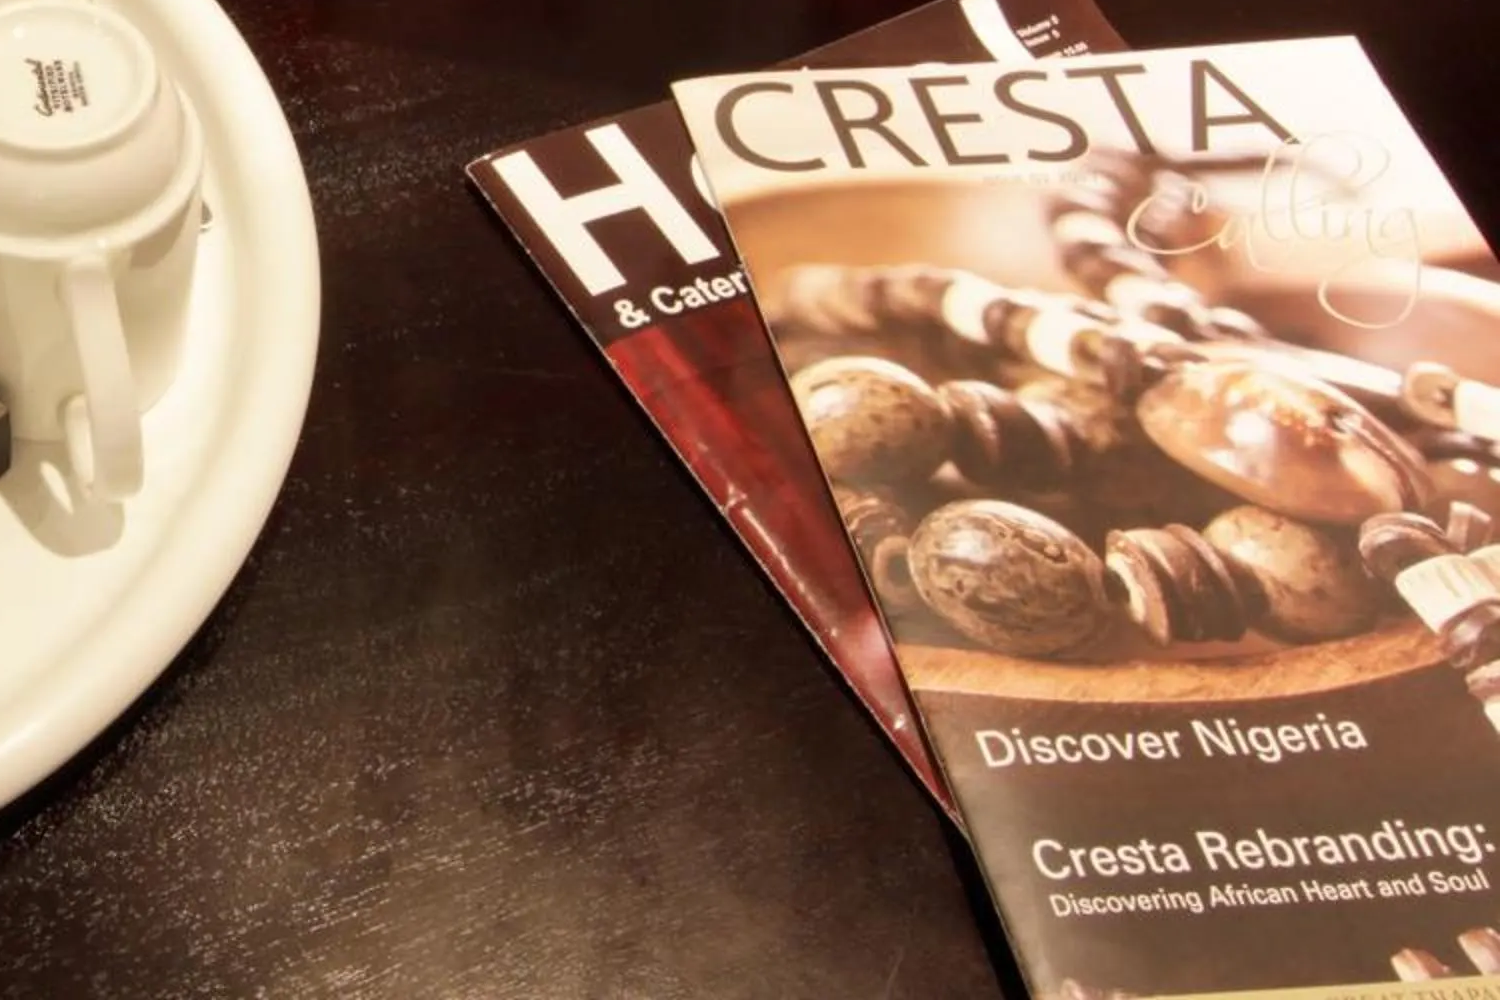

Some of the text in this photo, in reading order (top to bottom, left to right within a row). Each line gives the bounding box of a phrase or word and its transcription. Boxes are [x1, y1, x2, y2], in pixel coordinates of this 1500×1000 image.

[714, 58, 1301, 174] CRESTA
[1127, 130, 1422, 330] Calling
[612, 269, 750, 329] & Cater
[974, 712, 1370, 770] Discover Nigeria
[1031, 819, 1497, 881] Cresta Rebranding:
[1049, 868, 1491, 919] Discovering African Heart and Soul
